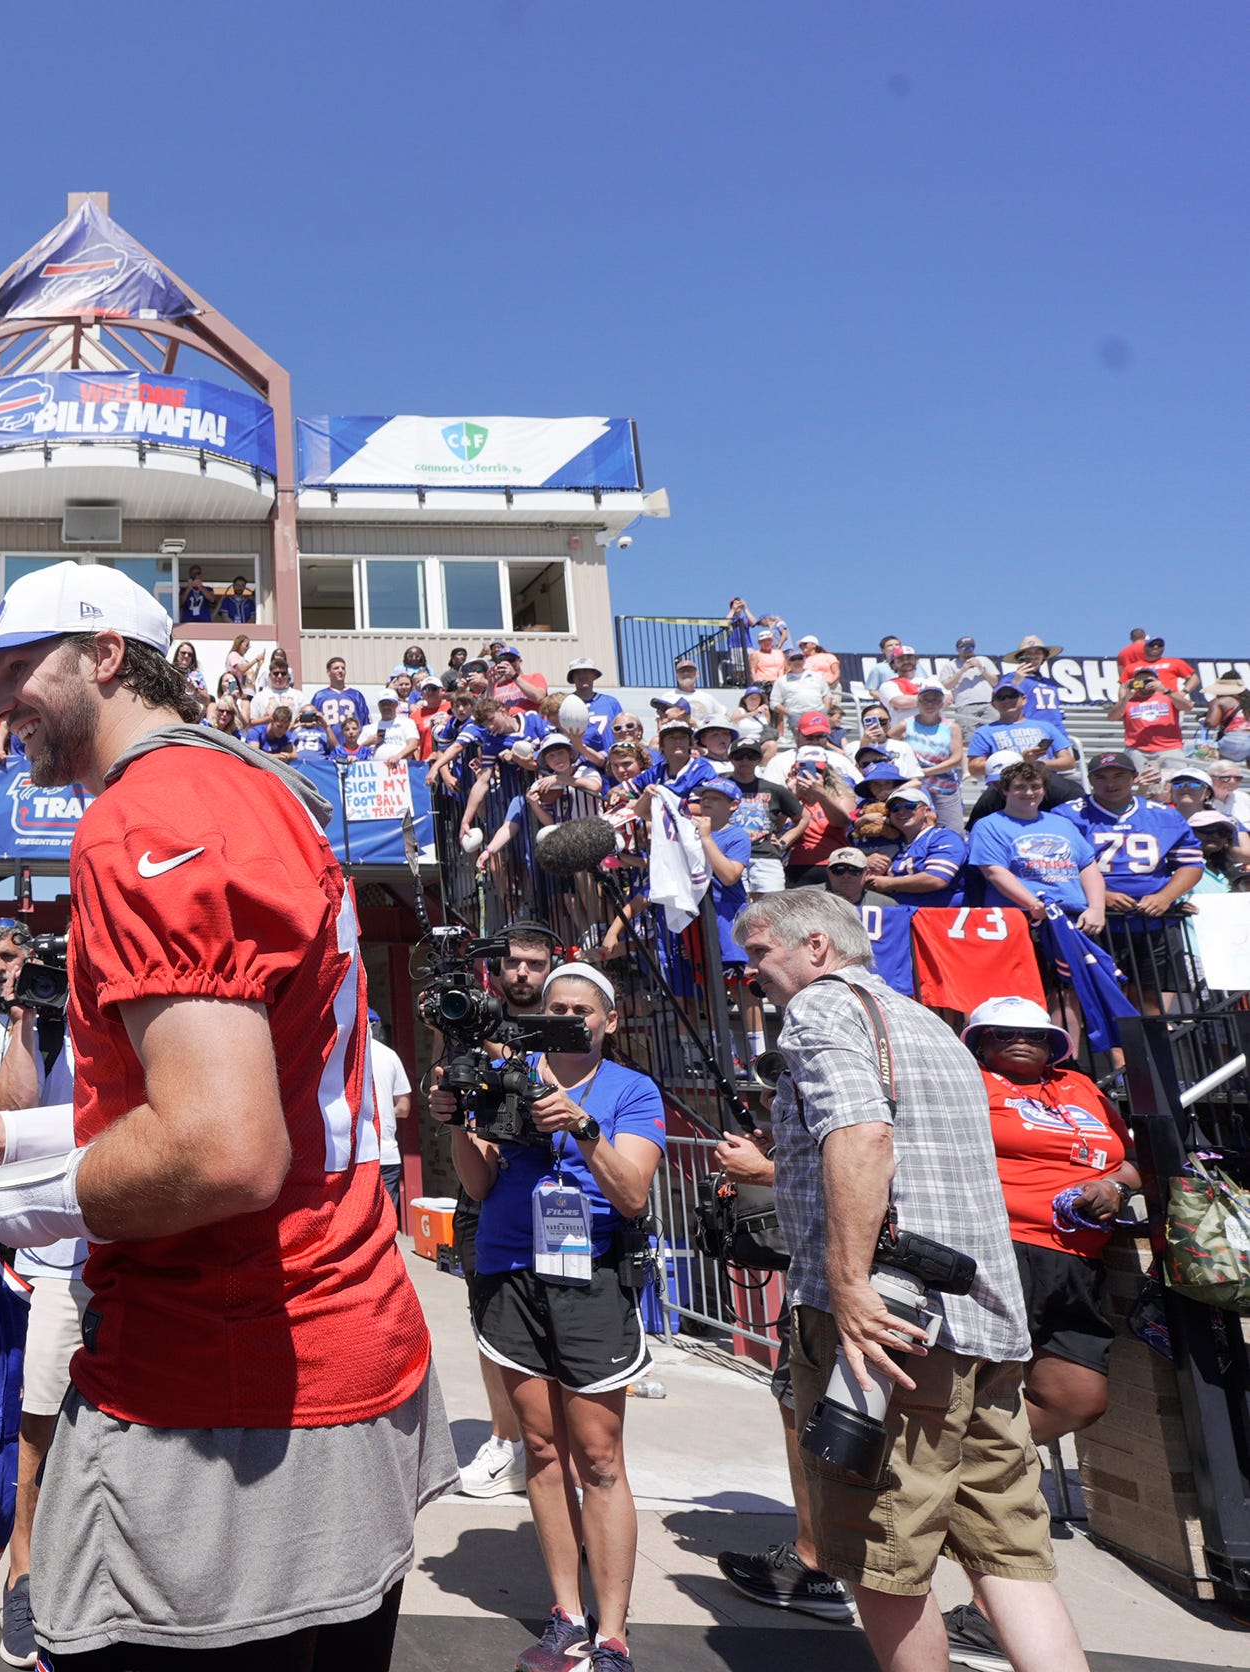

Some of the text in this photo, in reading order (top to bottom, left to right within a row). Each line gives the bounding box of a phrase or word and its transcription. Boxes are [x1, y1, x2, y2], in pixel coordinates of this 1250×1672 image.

[80, 383, 187, 407] WELCOME
[33, 400, 227, 447] BILLS MAFIA!
[448, 433, 484, 448] C&F
[414, 463, 459, 473] connors
[1033, 687, 1057, 709] 17
[322, 699, 356, 725] 83
[348, 763, 377, 777] WILL
[345, 779, 407, 793] SIGN MY
[346, 794, 403, 806] FOOTBALL
[15, 838, 60, 846] PRESENTED
[1093, 832, 1160, 875] 79
[880, 1038, 890, 1084] Canon
[546, 1208, 580, 1216] FILMS
[421, 1215, 430, 1237] G
[807, 1581, 845, 1594] HOKA
